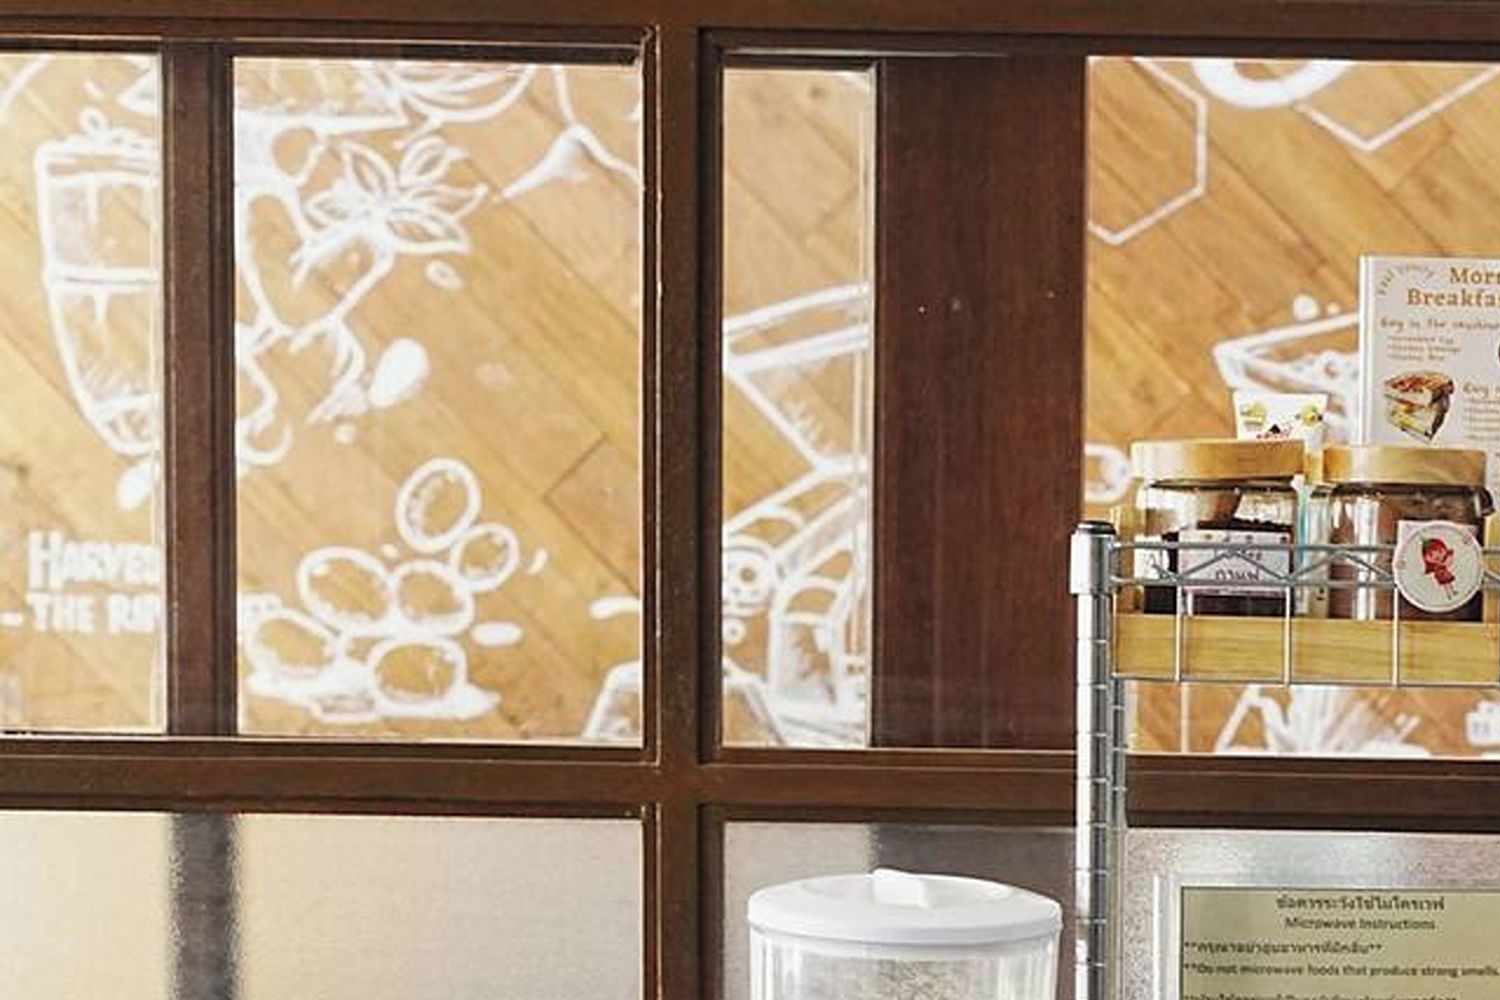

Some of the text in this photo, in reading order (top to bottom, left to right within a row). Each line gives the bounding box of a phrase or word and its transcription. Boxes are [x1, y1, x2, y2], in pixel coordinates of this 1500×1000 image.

[1285, 916, 1436, 930] Microwave Instructions
[1216, 964, 1238, 975] not
[1240, 964, 1303, 976] microwave
[1308, 963, 1339, 976] foods
[1342, 964, 1368, 977] that
[1369, 965, 1418, 980] produce
[1421, 965, 1459, 979] strong
[1461, 965, 1500, 977] smells.
